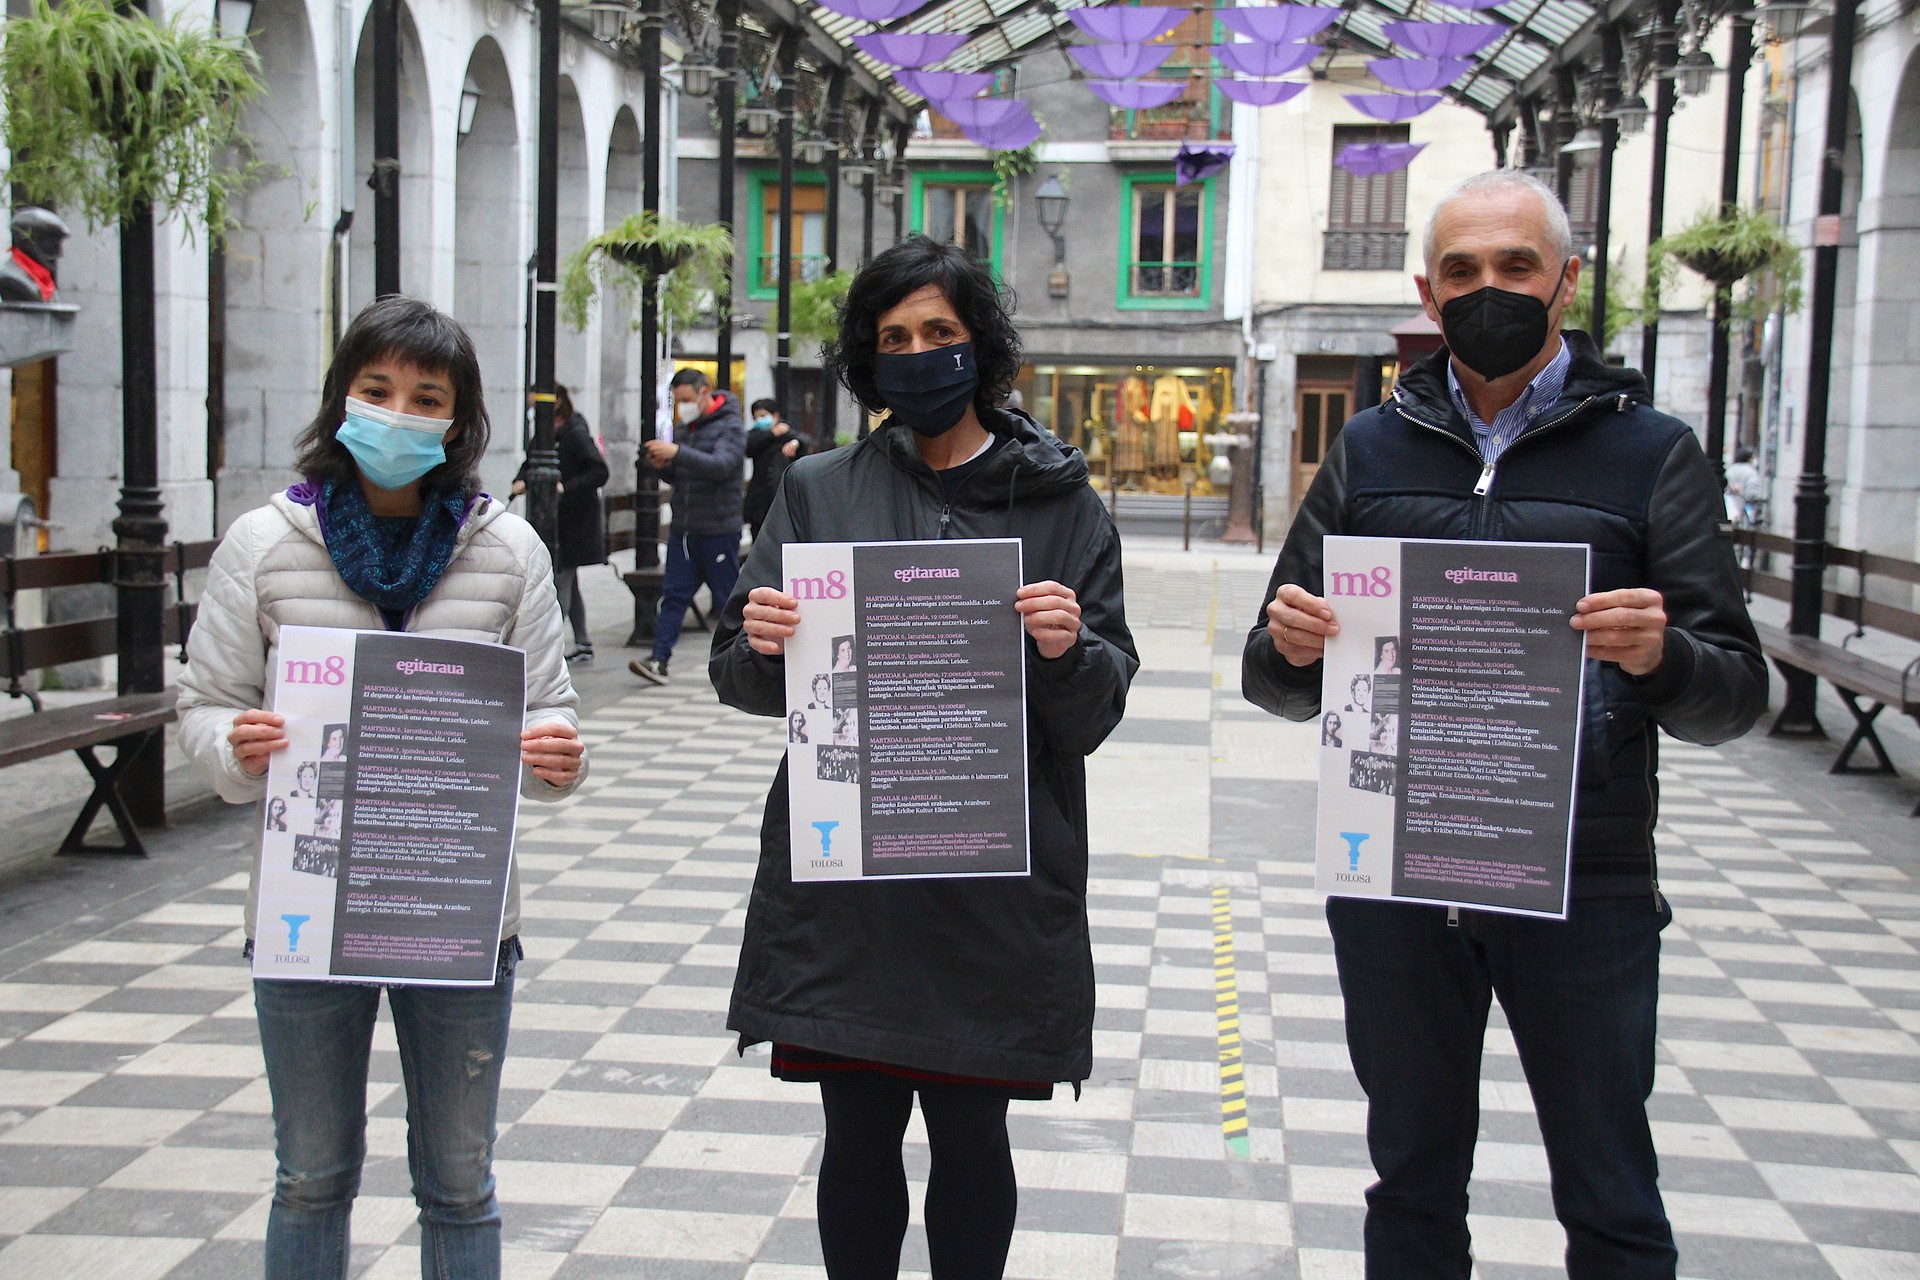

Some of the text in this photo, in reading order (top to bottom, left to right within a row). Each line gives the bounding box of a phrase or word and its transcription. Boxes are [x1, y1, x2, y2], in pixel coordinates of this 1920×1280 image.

[790, 569, 847, 600] m8
[894, 566, 960, 582] egitaraua
[1331, 566, 1392, 598] m8
[1444, 566, 1518, 584] egitaraua
[285, 655, 345, 686] m8
[396, 658, 465, 675] egitaraua
